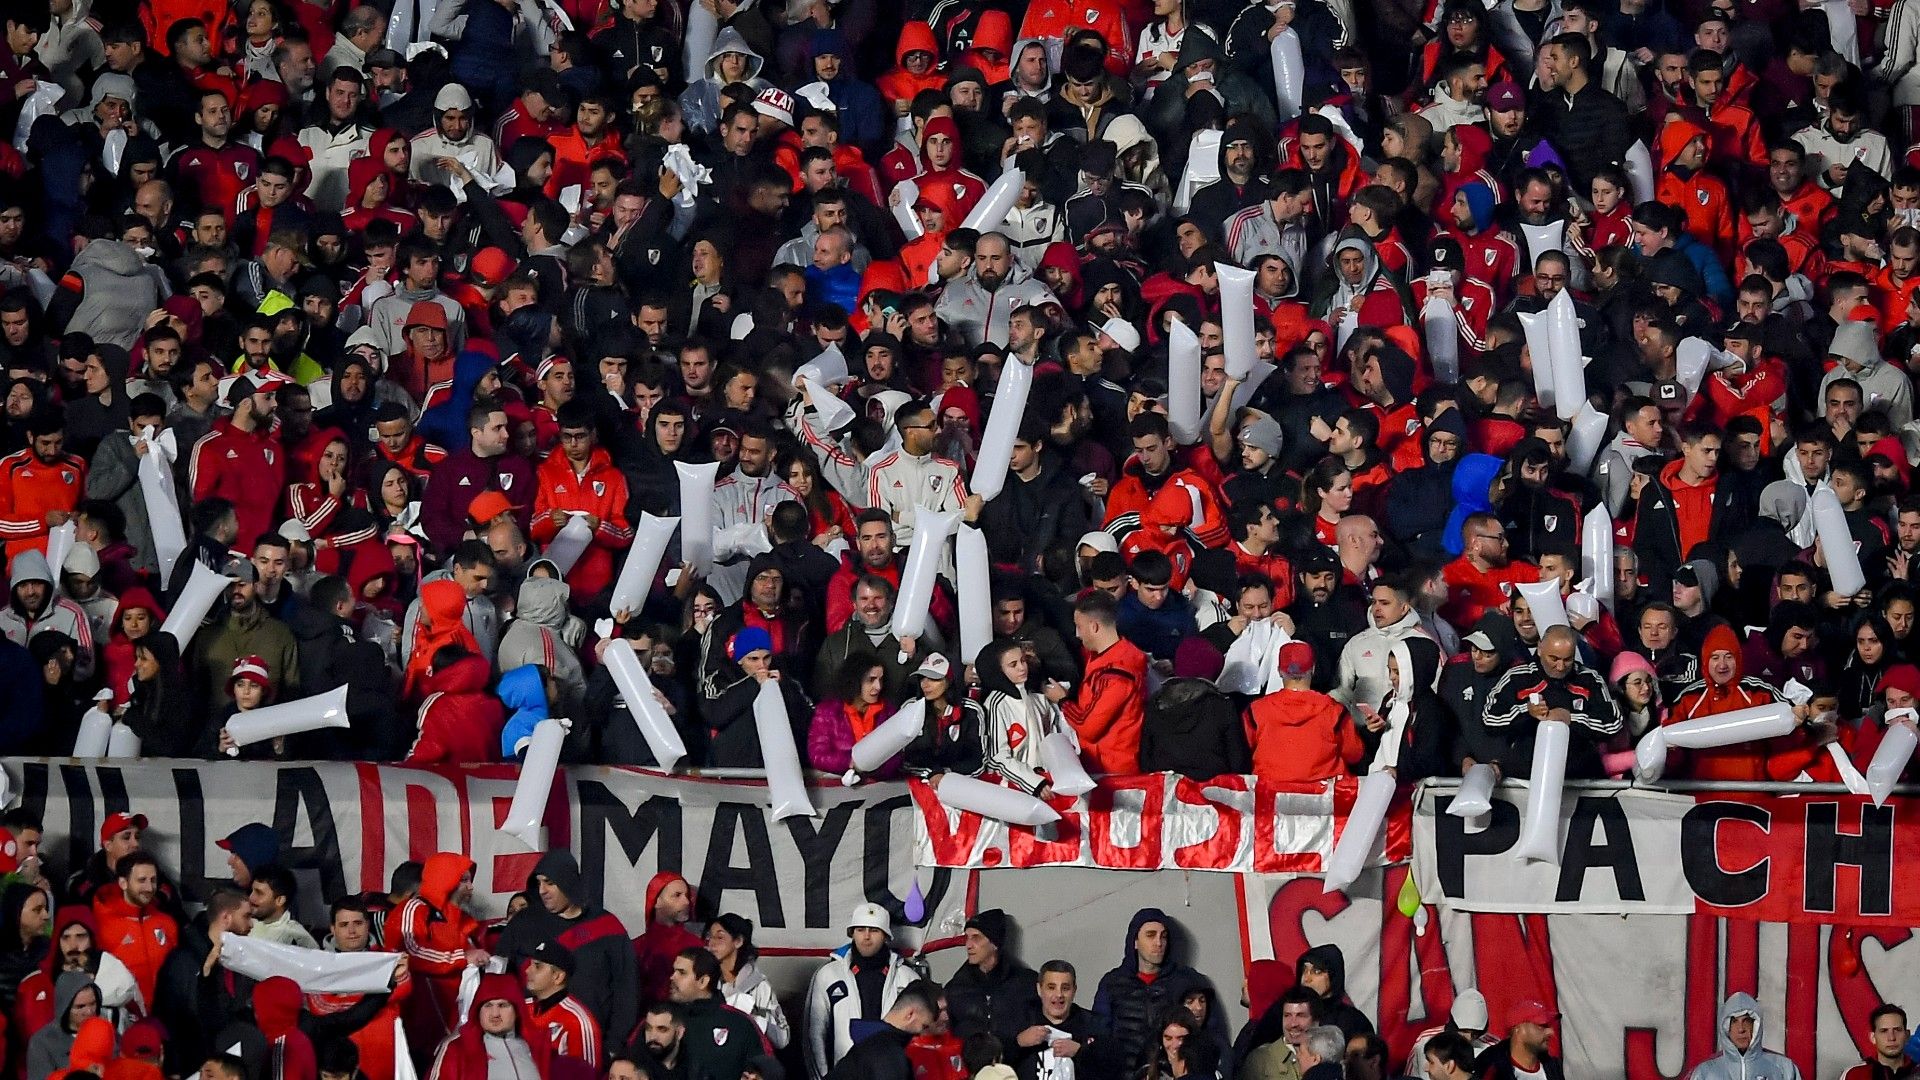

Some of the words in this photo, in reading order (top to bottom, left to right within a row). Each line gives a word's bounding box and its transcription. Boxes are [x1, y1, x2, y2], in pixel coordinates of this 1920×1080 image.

[20, 763, 347, 905] ILA
[577, 780, 952, 929] MAYO
[1434, 795, 1894, 915] PACH
